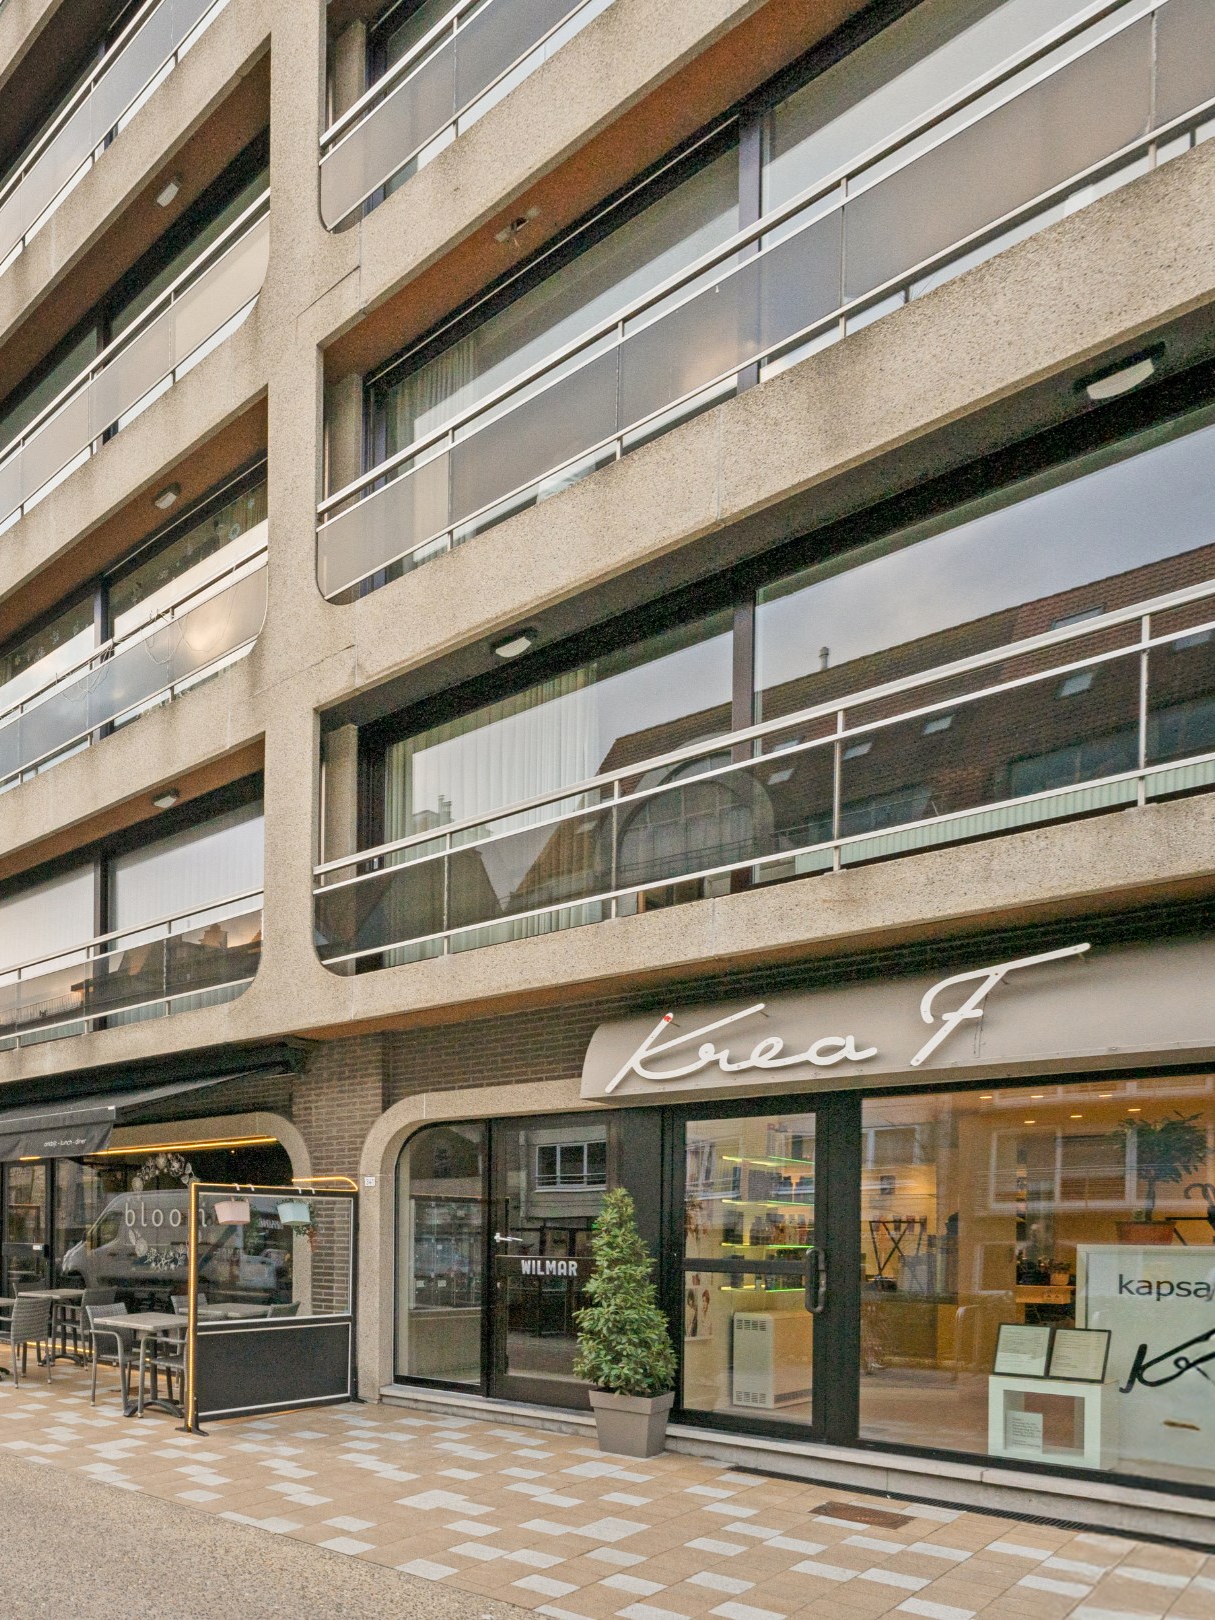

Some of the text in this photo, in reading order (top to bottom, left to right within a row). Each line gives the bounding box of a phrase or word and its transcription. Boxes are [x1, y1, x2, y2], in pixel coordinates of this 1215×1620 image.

[605, 943, 1090, 1093] Krea F
[521, 1260, 578, 1276] WILMAR
